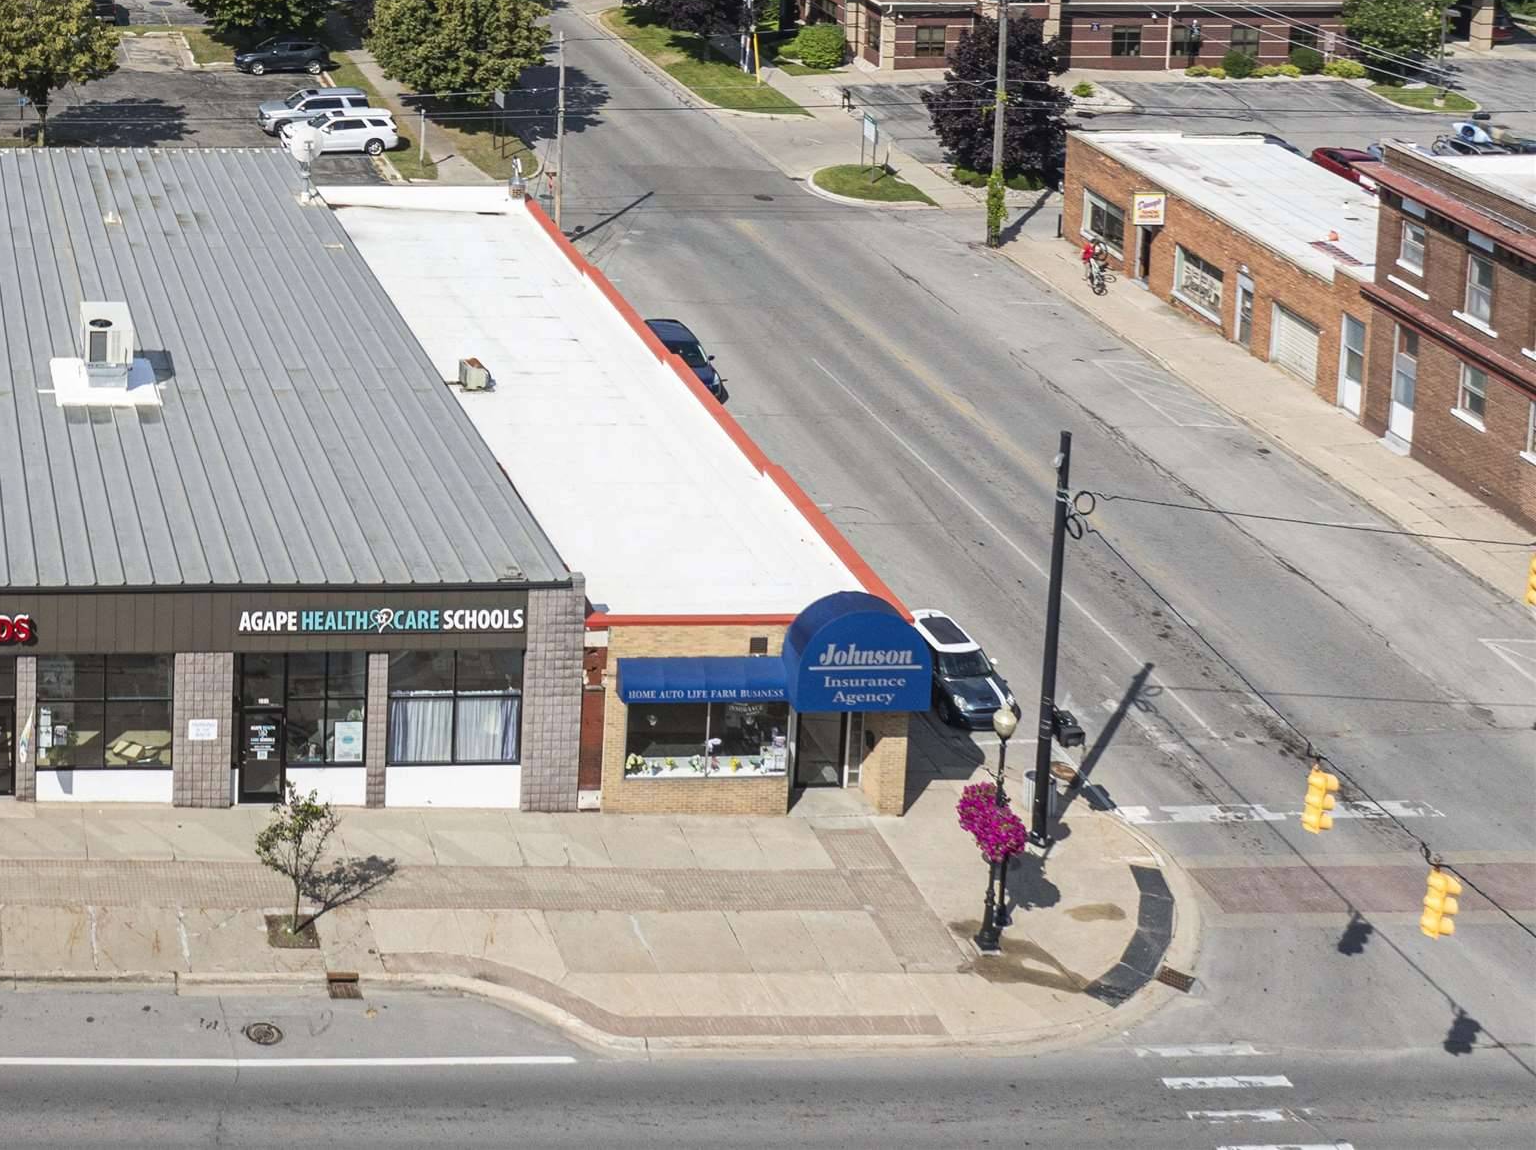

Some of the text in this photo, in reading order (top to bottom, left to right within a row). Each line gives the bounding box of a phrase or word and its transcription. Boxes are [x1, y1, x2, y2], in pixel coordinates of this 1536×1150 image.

[238, 609, 524, 631] AGAPE HEALTH CARE SCHOOLS
[819, 643, 913, 665] Johnson
[824, 676, 906, 687] Insurance
[628, 689, 784, 699] HOME AUTO LIFE FARM BUSINESS
[832, 691, 895, 705] Agency
